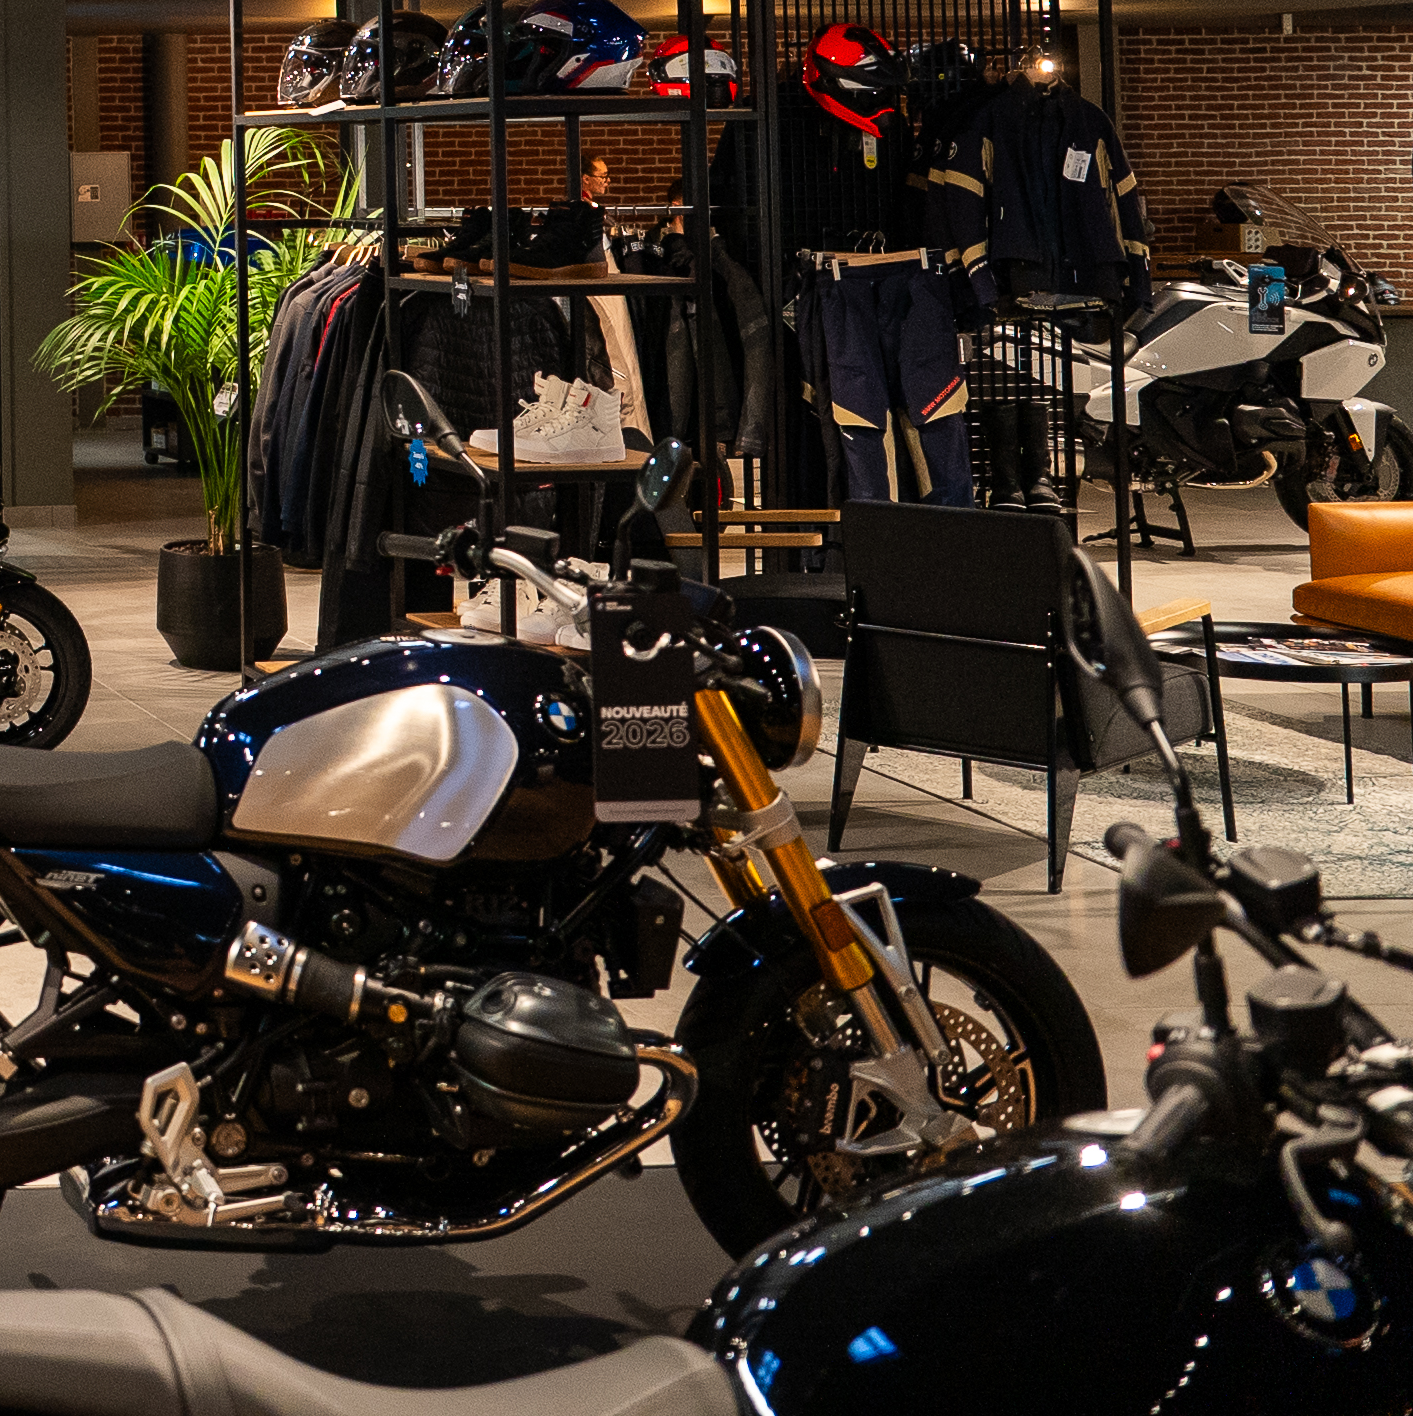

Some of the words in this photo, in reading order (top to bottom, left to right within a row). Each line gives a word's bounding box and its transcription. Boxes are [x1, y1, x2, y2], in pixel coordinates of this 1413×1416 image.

[600, 701, 689, 719] NOUVEAUTÉ
[601, 719, 690, 749] 2026
[818, 1083, 840, 1136] brembo
